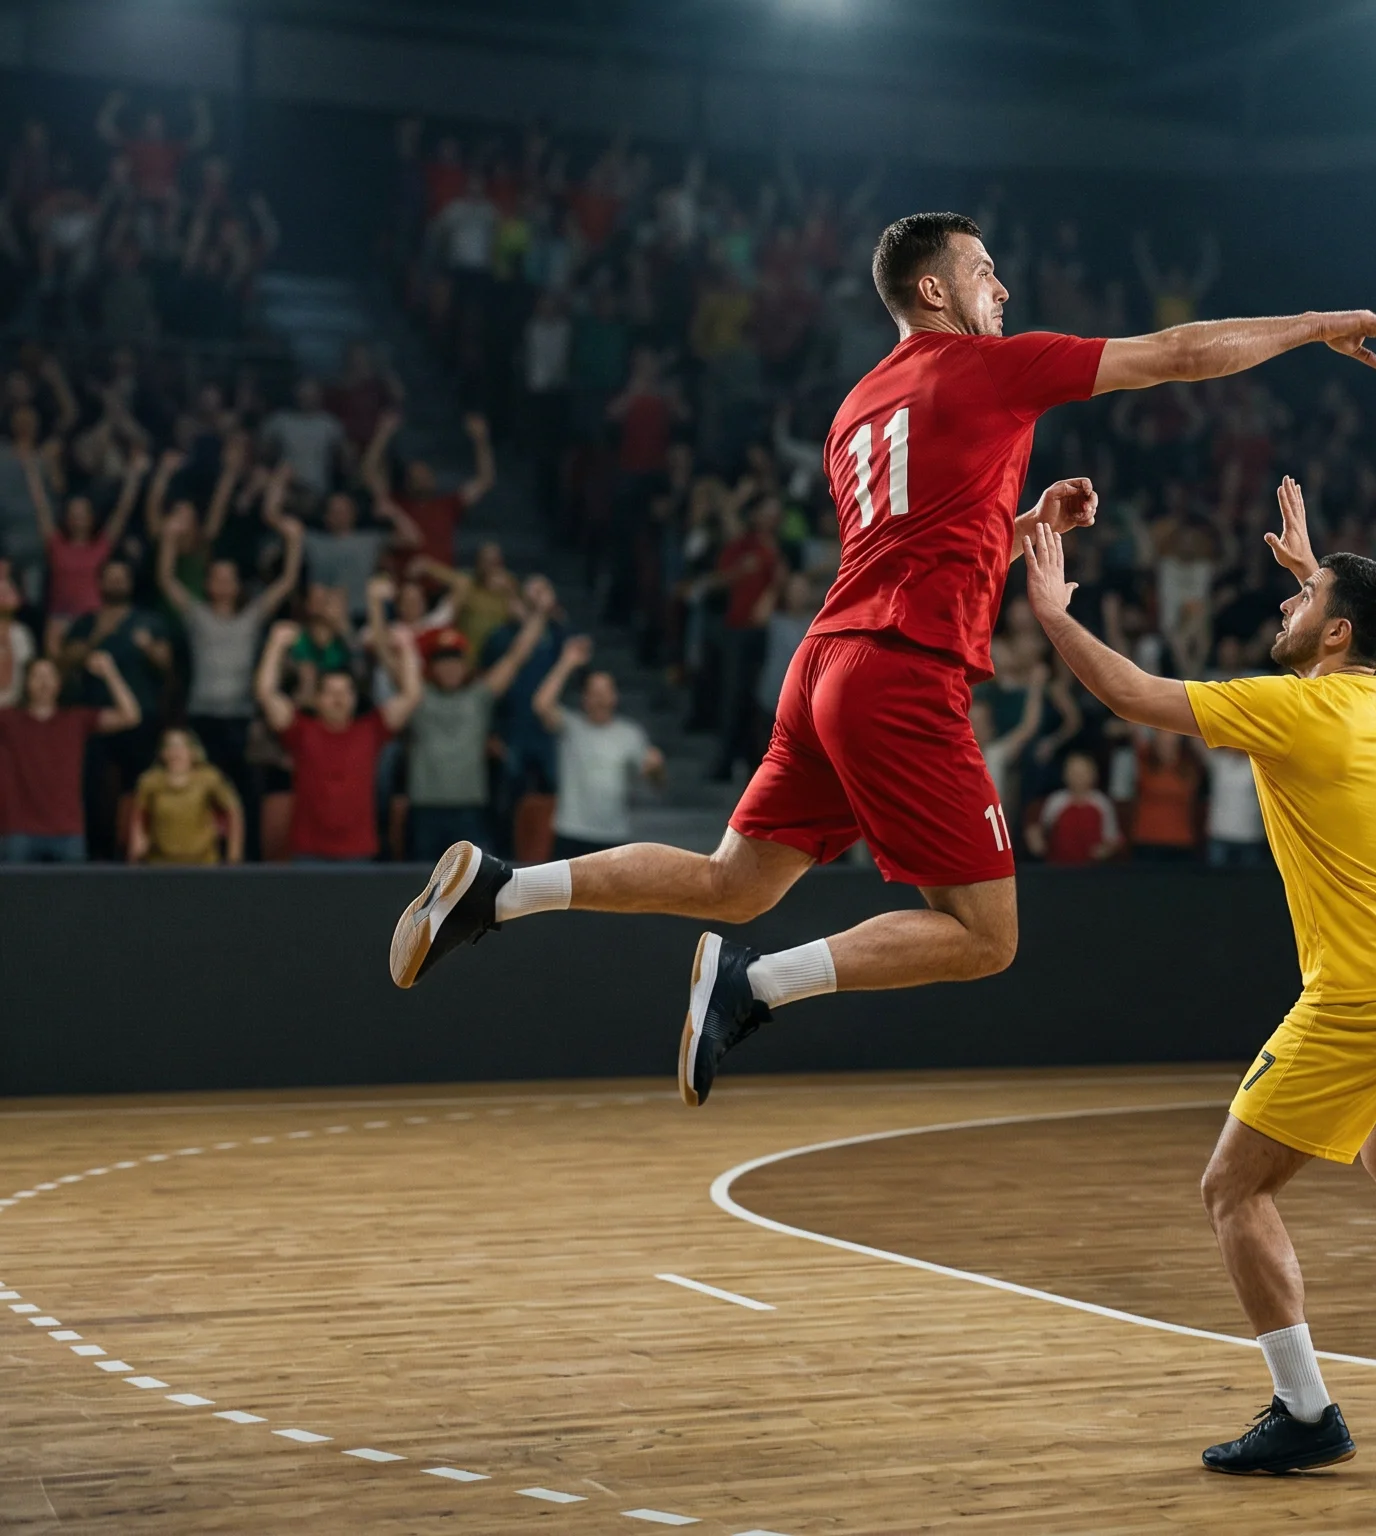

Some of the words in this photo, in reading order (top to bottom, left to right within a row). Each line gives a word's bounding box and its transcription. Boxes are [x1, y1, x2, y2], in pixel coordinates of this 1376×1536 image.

[848, 407, 909, 529] 11
[984, 803, 1011, 851] 11
[1243, 1050, 1276, 1091] 7
